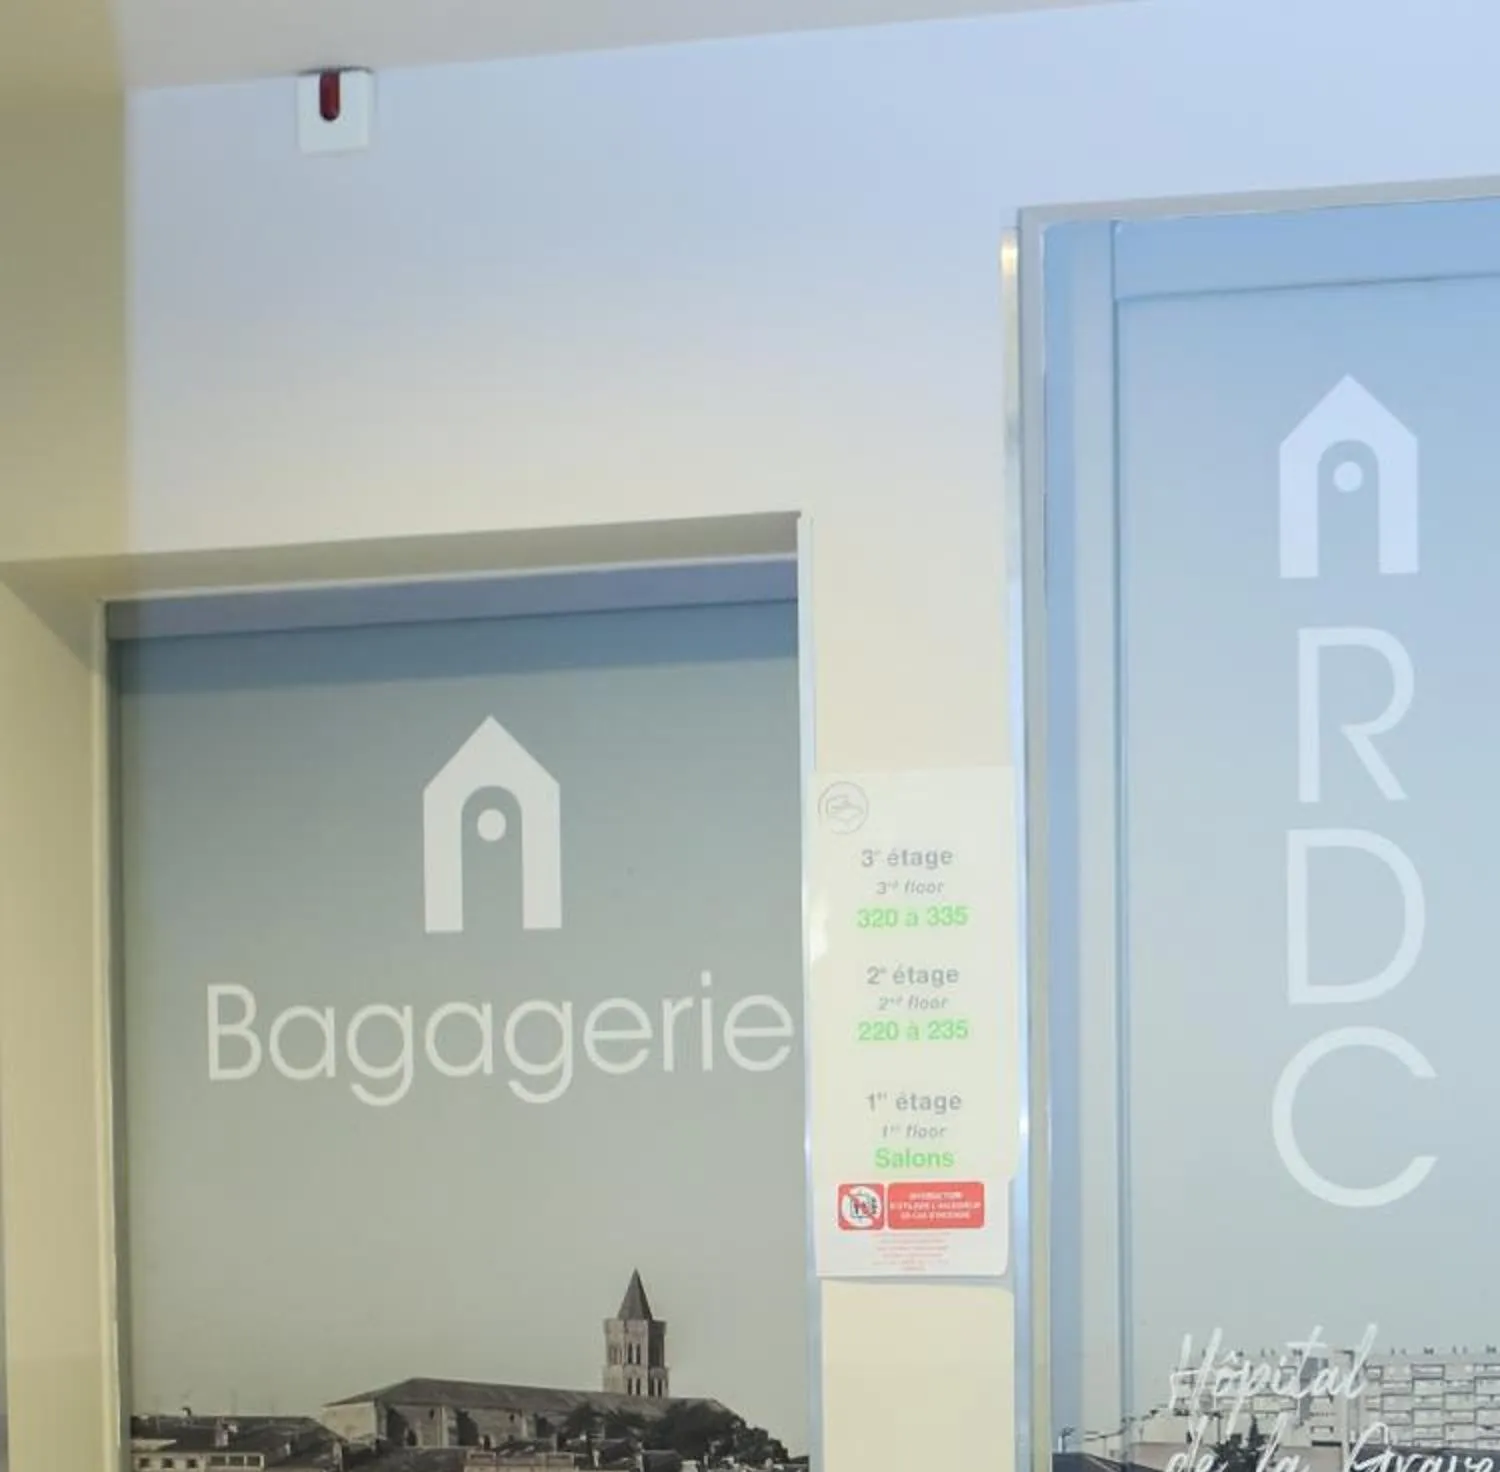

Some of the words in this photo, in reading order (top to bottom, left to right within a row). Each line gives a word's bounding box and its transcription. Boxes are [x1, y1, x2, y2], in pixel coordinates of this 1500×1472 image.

[887, 847, 953, 870] étage
[904, 878, 944, 894] floor
[857, 907, 899, 928] 320
[927, 905, 969, 926] 335
[1271, 627, 1438, 1208] RDC
[892, 963, 960, 988] étage
[908, 995, 949, 1010] floor
[206, 970, 795, 1107] Bagagerie
[858, 1021, 899, 1041] 220
[927, 1019, 969, 1041] 235
[896, 1089, 962, 1115] étage
[906, 1124, 947, 1139] floor
[875, 1147, 955, 1168] Salons
[1170, 1324, 1376, 1435] Hôpital
